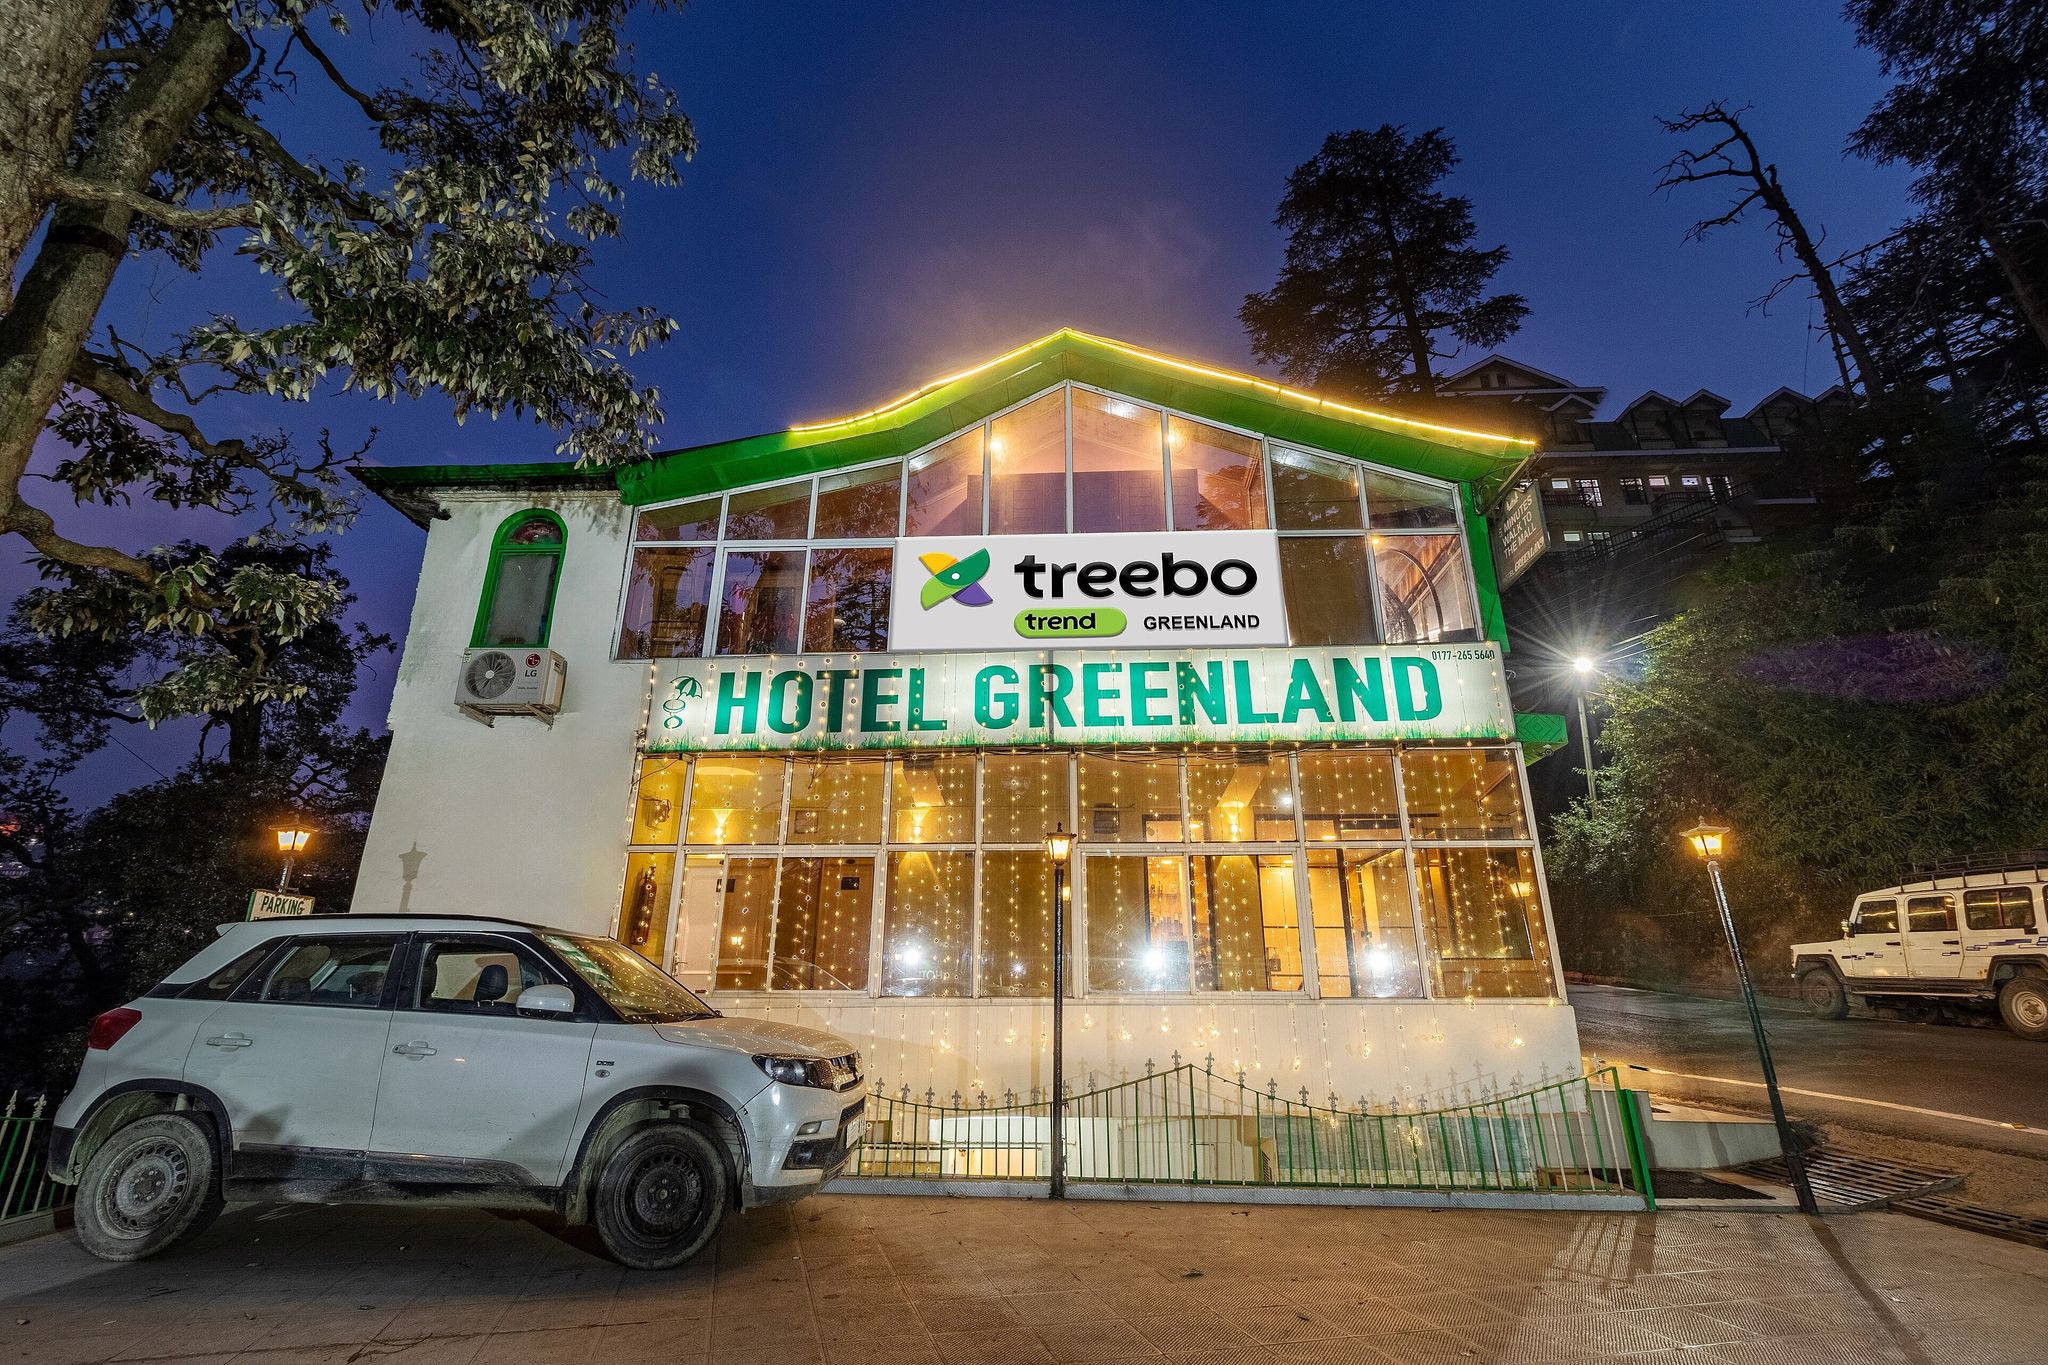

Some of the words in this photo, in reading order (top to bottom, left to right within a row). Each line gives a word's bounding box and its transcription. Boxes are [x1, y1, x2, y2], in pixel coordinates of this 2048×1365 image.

[1503, 495, 1533, 533] MINUTES
[1502, 521, 1522, 547] WALK
[1523, 511, 1532, 526] TO
[1504, 540, 1518, 559] THE
[1518, 522, 1537, 546] MALL
[1013, 552, 1258, 598] treebo
[1025, 612, 1096, 631] trend
[1143, 614, 1260, 631] GREENLAND
[1431, 650, 1473, 661] 0177-265
[1474, 649, 1495, 660] 5640
[525, 669, 537, 677] LG
[714, 667, 948, 735] HOTEL
[974, 655, 1443, 730] GREENLAND
[261, 895, 305, 915] PARKING
